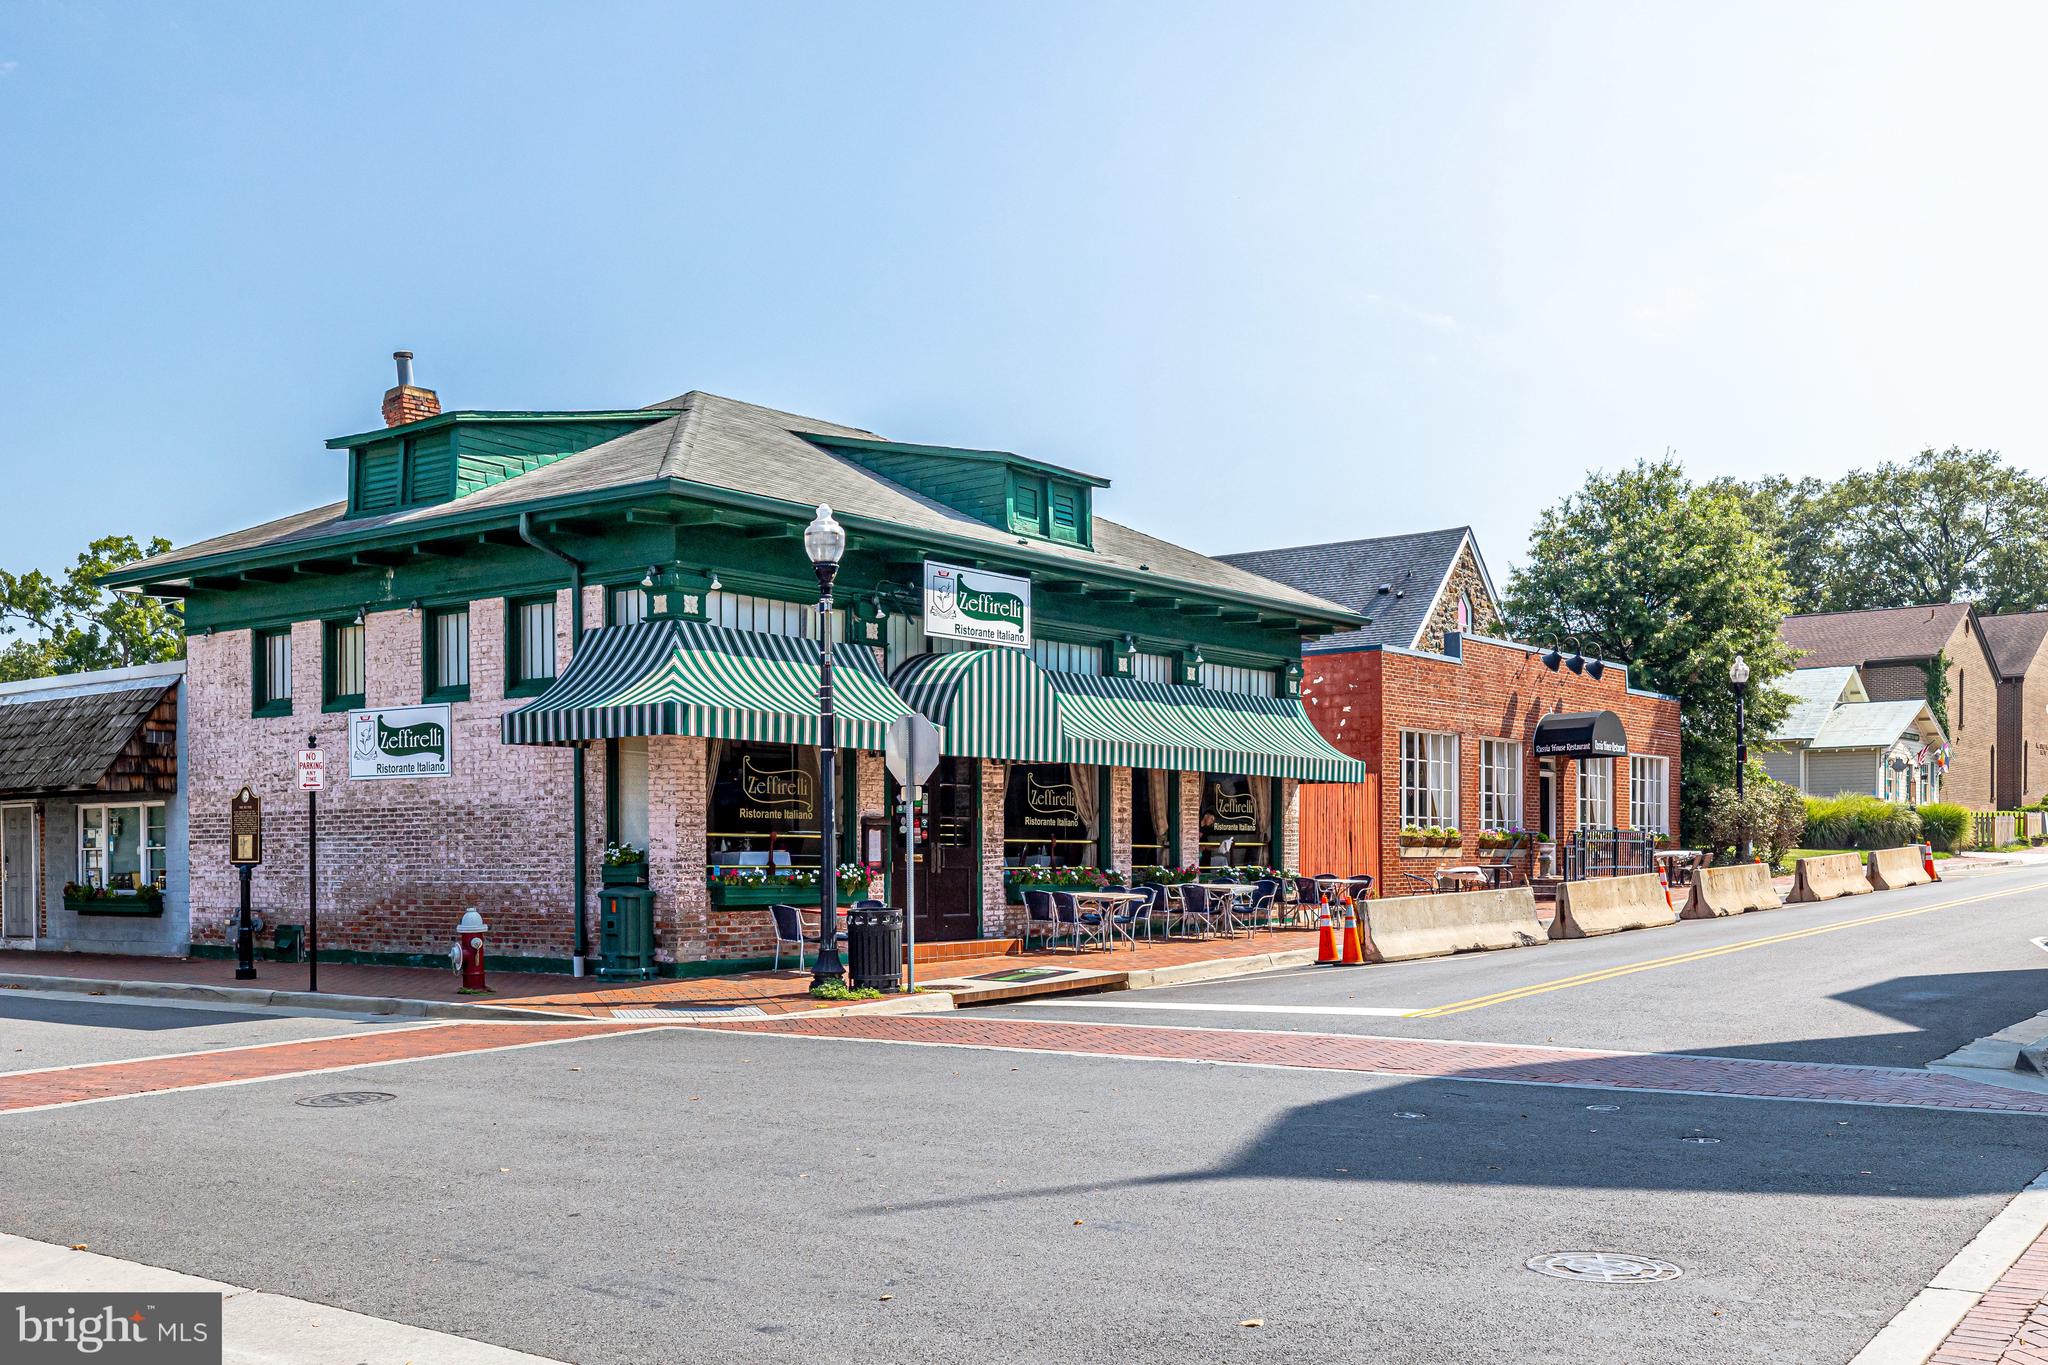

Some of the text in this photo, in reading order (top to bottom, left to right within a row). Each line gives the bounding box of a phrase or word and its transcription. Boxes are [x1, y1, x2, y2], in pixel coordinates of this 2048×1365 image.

[959, 591, 1021, 618] Zeffirelli
[954, 623, 1025, 643] Ristorante Italiano
[380, 727, 442, 749] Zeffirelli
[1551, 744, 1566, 752] House
[1566, 742, 1591, 752] Restaurant
[305, 752, 316, 761] NO
[299, 762, 323, 770] PARKING
[376, 762, 445, 774] Ristorante Italiano
[748, 776, 808, 796] Zeffirelli
[1031, 789, 1075, 806] Zeffirelli
[1219, 798, 1253, 813] Zeffirelli
[739, 807, 813, 820] Ristorante Italiano
[1024, 816, 1079, 827] Ristorante Italiano
[1213, 822, 1257, 831] Ristorante Italiano
